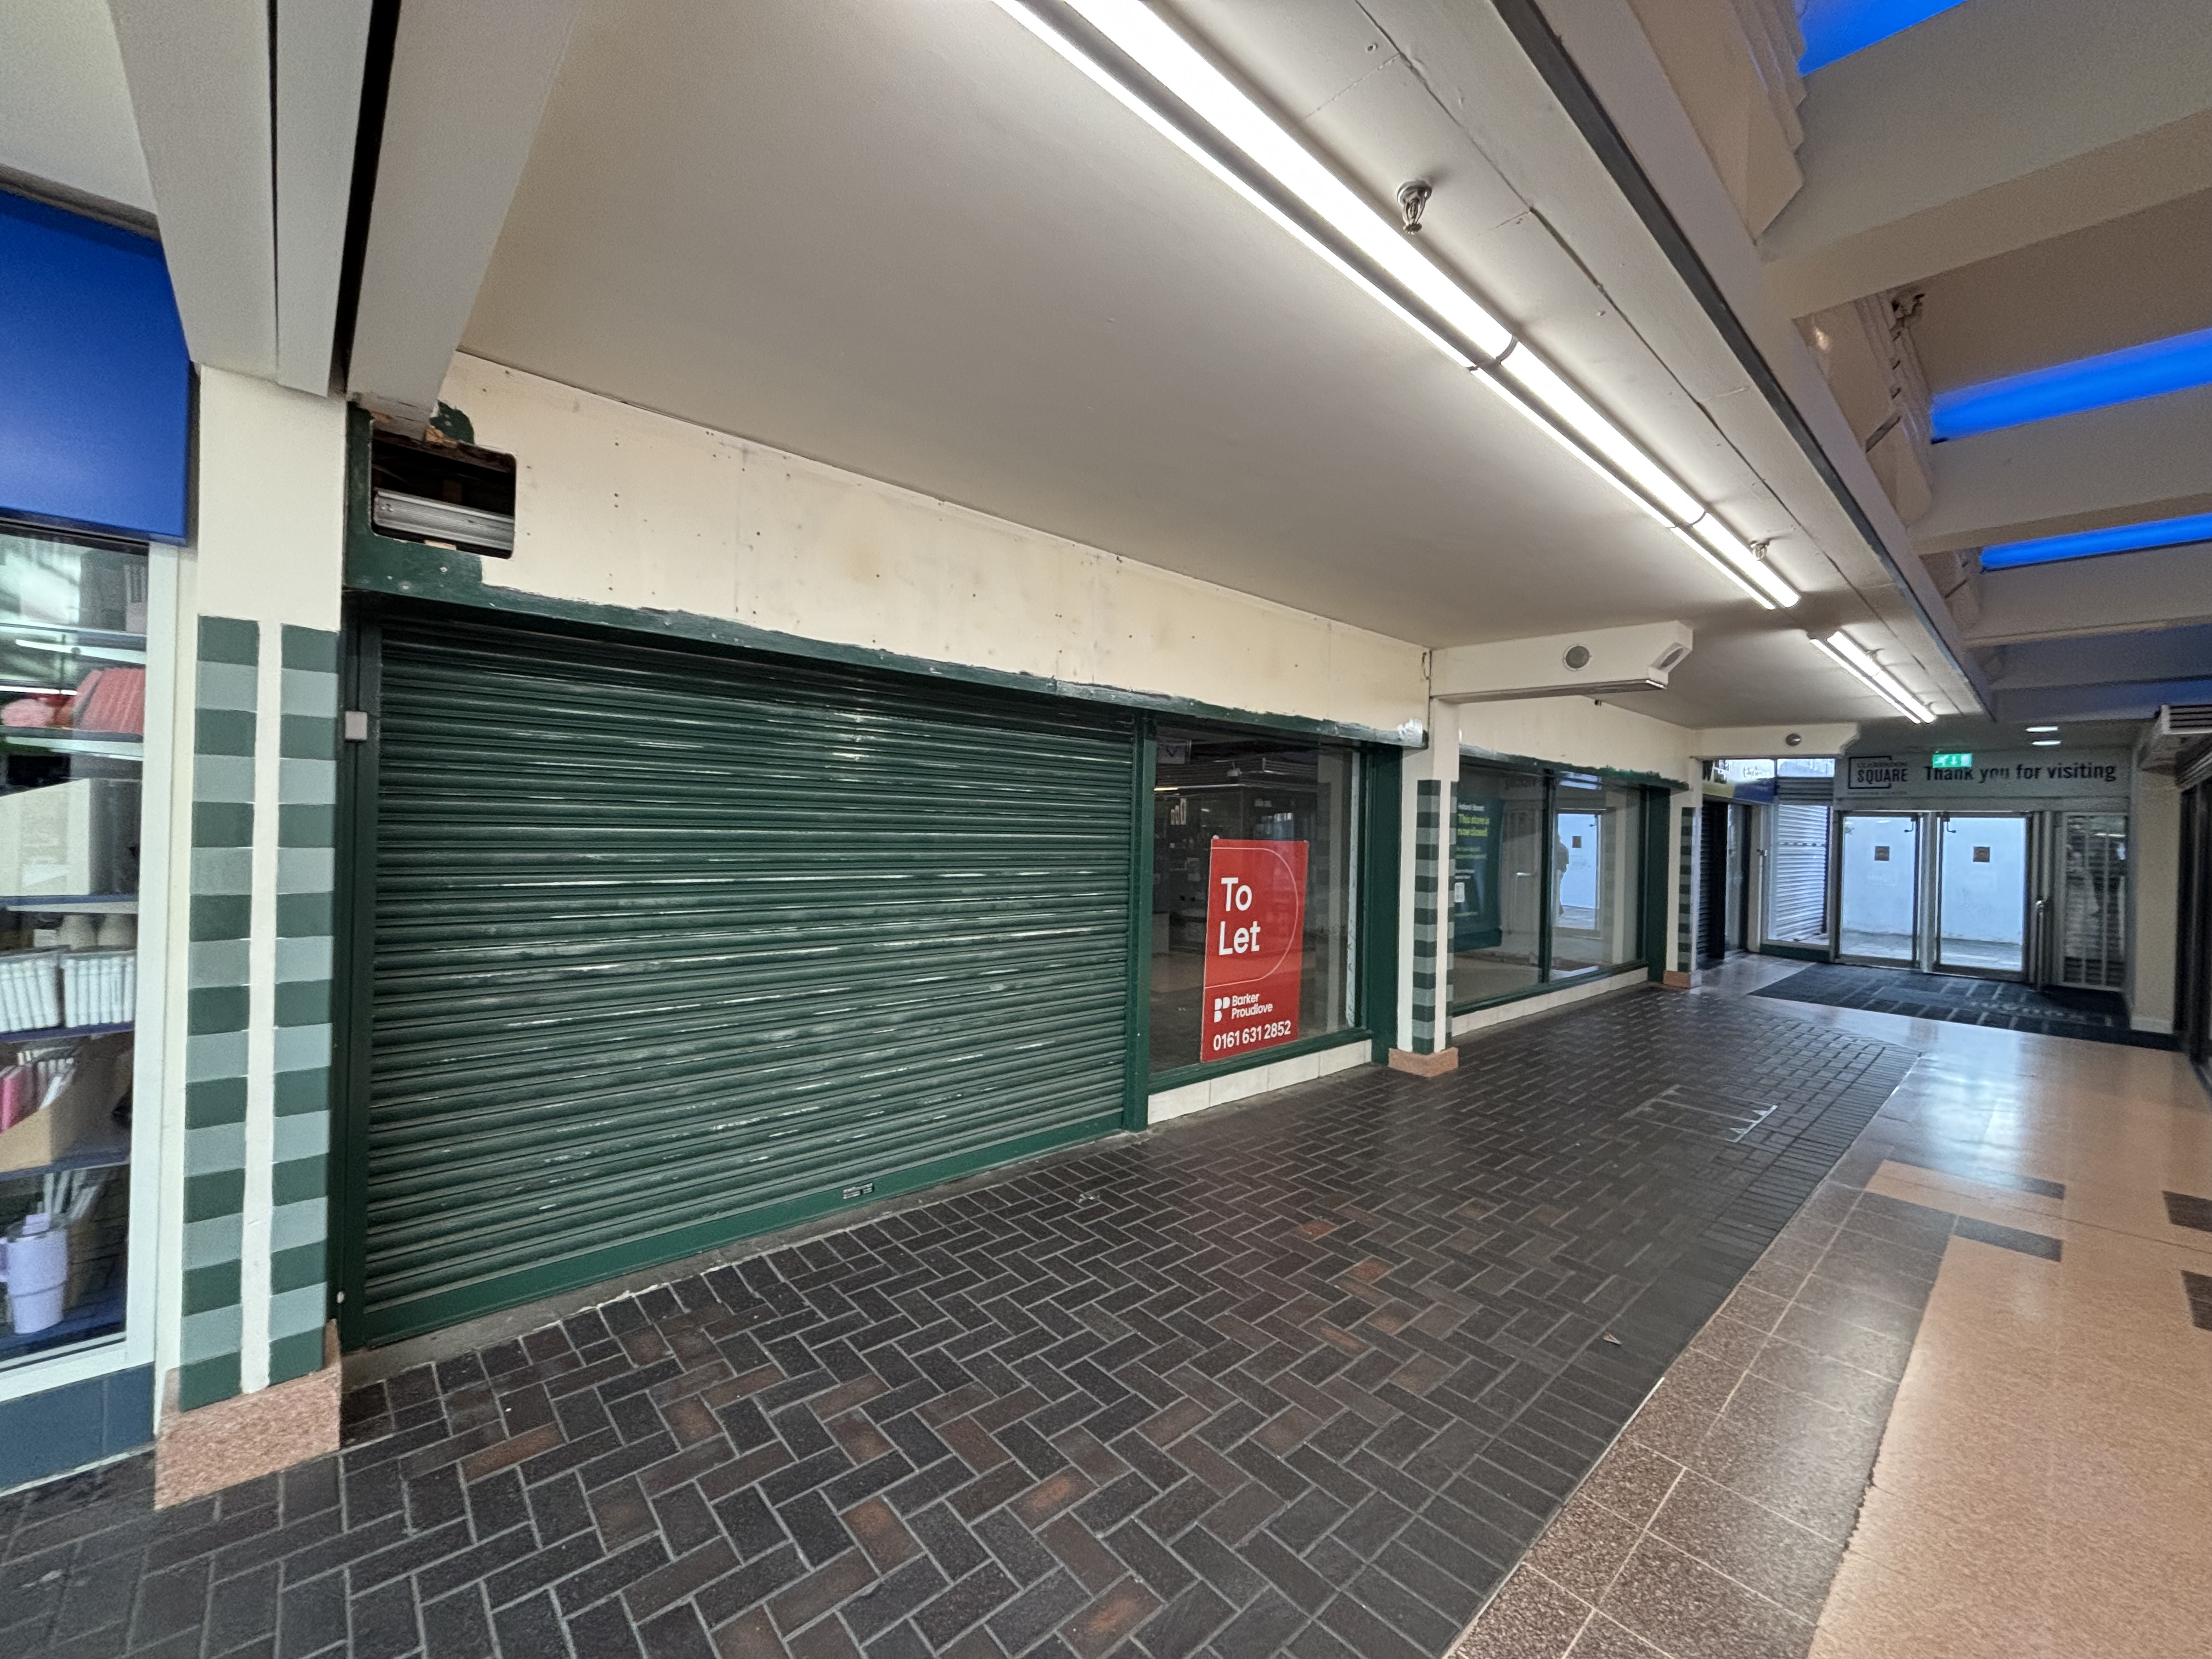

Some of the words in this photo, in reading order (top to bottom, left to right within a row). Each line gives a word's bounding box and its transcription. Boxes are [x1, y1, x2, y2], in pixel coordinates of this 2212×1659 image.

[1857, 768, 1908, 784] SQUARE
[1924, 766, 1973, 781] Thank
[1978, 768, 2010, 783] you
[2017, 764, 2041, 779] for
[2047, 762, 2116, 782] visiting
[1221, 877, 1252, 911] To
[1219, 921, 1261, 955] Let
[1231, 1003, 1273, 1019] Proudlove
[1232, 994, 1260, 1007] Barker
[1213, 1030, 1240, 1051] 0161
[1242, 1025, 1262, 1044] 631
[1263, 1020, 1291, 1039] 2852
